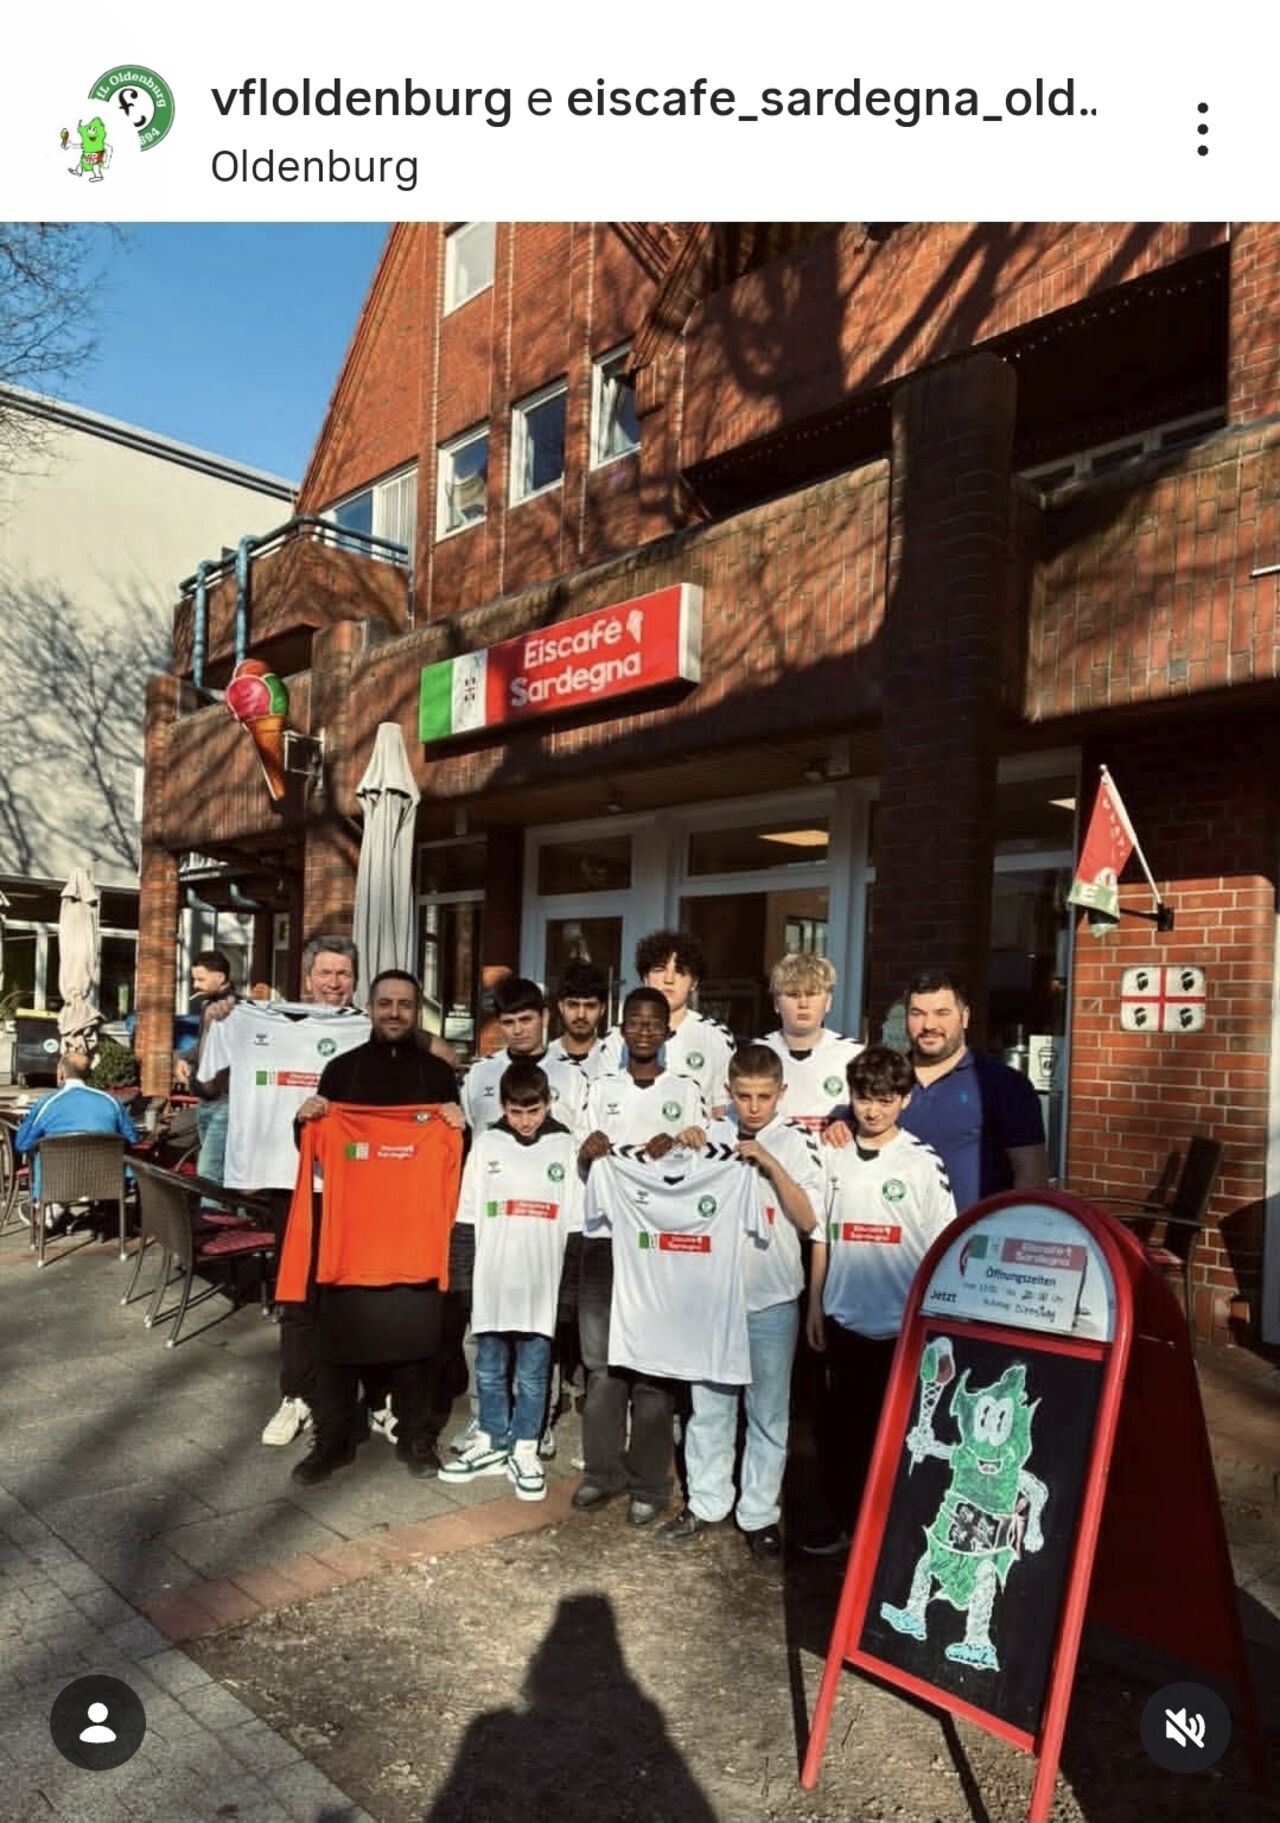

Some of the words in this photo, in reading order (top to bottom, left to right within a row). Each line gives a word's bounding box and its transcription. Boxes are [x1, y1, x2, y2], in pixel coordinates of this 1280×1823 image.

[509, 652, 641, 707] Sardegna
[986, 1265, 1057, 1286] Öffnungszeiten
[930, 1289, 957, 1304] Jetzt
